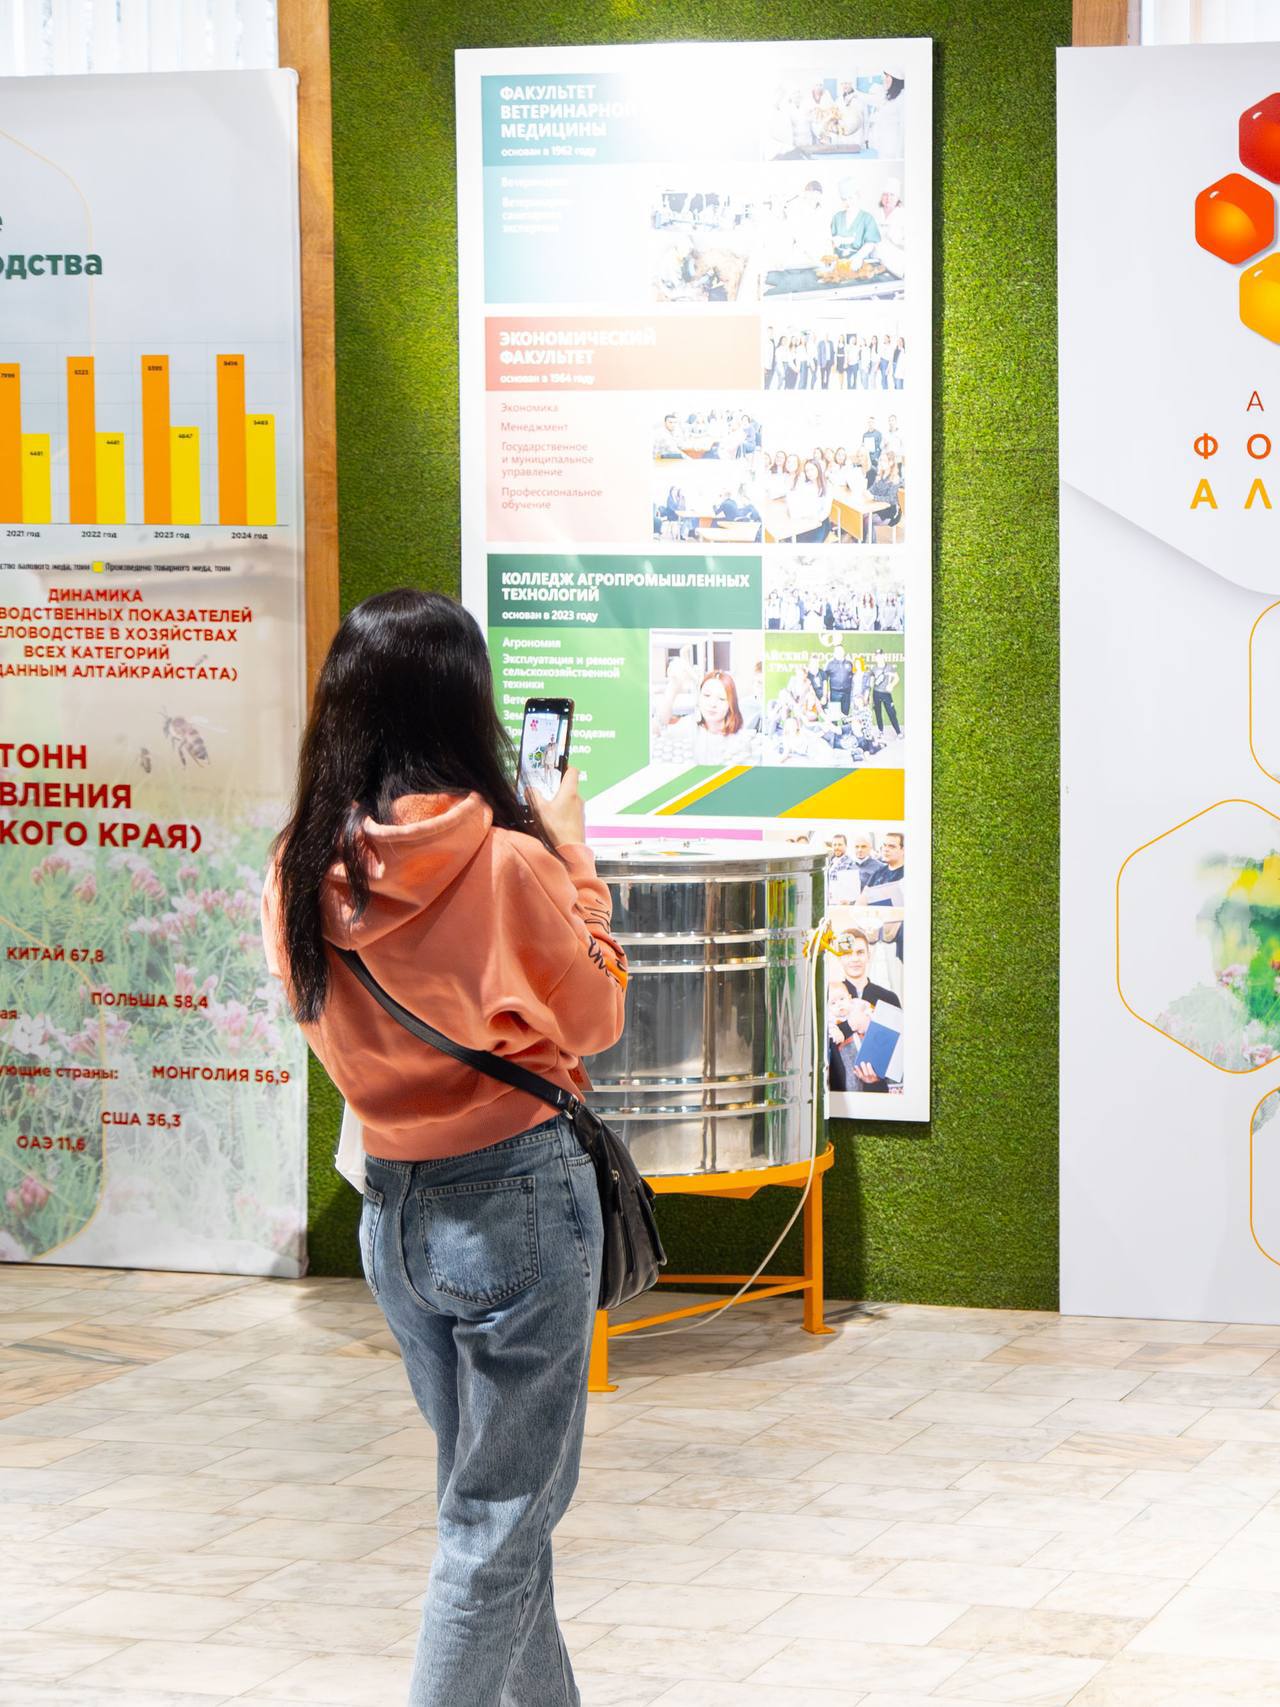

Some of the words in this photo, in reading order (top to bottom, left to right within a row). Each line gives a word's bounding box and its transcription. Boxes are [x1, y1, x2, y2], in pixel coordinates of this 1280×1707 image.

[500, 84, 596, 100] ФАКУЛЬТЕТ
[501, 121, 607, 140] МЕДИЦИНЫ
[500, 327, 656, 346] ЭКОНОМИЧЕСКИЙ
[500, 349, 594, 364] ФАКУЛЬТЕТ
[501, 402, 558, 413] Экономика
[501, 422, 568, 434] Менеджмент
[501, 441, 588, 455] Государственное
[501, 468, 563, 479] управление
[501, 487, 603, 500] Профессиональное
[501, 499, 552, 512] обучение
[502, 572, 574, 588] КОЛЛЕДЖ
[577, 573, 750, 588] АГРОПРОМЫШЛЕННЫХ
[48, 588, 143, 602] ДИНАМИКА
[502, 585, 600, 601] ТЕХНОЛОГИЙ
[0, 608, 123, 622] ВОДСТВЕННЫХ
[129, 607, 252, 623] ПОКАЗАТЕЛЕЙ
[502, 611, 541, 620] основан
[552, 610, 574, 620] 2023
[576, 612, 598, 623] году
[0, 627, 105, 640] ЕЛОВОДСТВЕ
[110, 628, 120, 640] В
[126, 626, 237, 642] ХОЗЯЙСТВАХ
[503, 637, 561, 649] Агрономия
[24, 645, 66, 658] ВСЕХ
[71, 644, 170, 660] КАТЕГОРИЙ
[503, 654, 574, 667] Эксплуатация
[586, 656, 625, 668] ремонт
[0, 664, 67, 678] ДАННЫМ
[72, 662, 238, 681] АЛТАЙКРАЙСТАТА)
[503, 680, 544, 689] техники
[0, 743, 87, 769] ТОНН
[0, 782, 131, 809] ВЛЕНИЯ
[0, 820, 88, 846] КОГО
[99, 822, 202, 853] КРАЯ)
[7, 945, 65, 962] КИТАЙ
[70, 949, 105, 963] 67,8
[90, 992, 168, 1008] ПОЛЬША
[174, 995, 208, 1010] 58,4
[55, 1067, 118, 1080] страны:
[152, 1066, 249, 1082] МОНГОЛИЯ
[254, 1069, 290, 1085] 56,9
[101, 1112, 140, 1126] США
[147, 1114, 181, 1128] 36,3
[16, 1136, 54, 1150] ОАЭ
